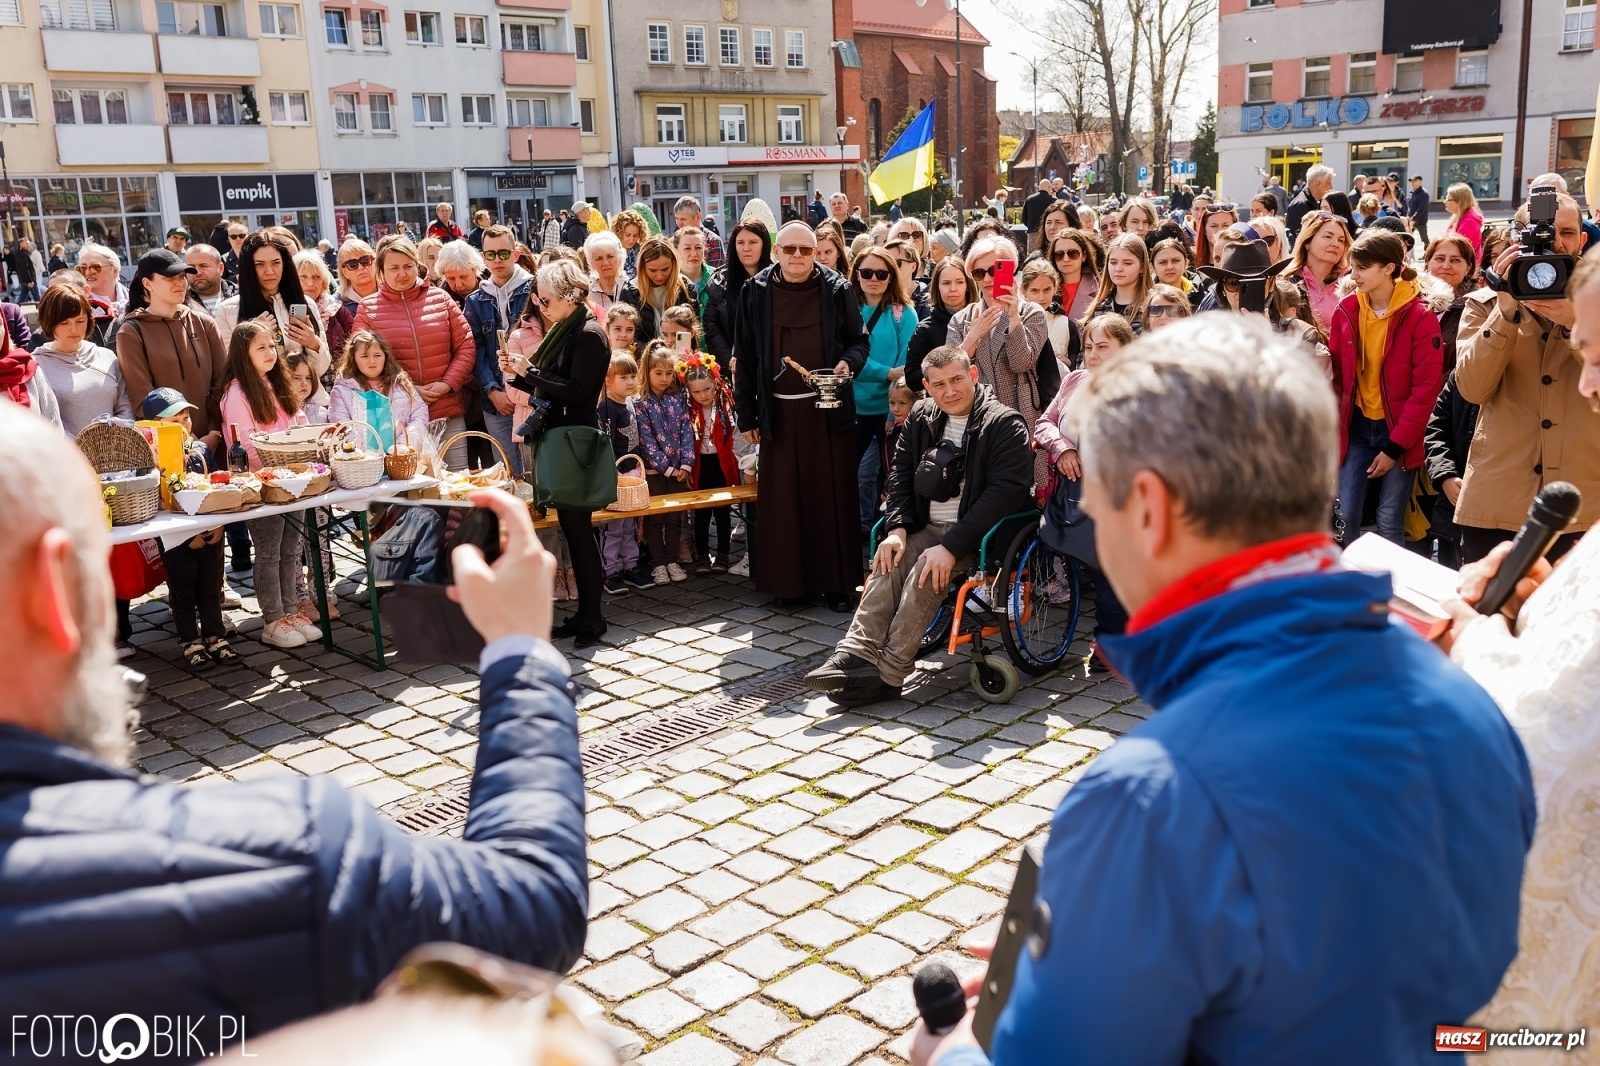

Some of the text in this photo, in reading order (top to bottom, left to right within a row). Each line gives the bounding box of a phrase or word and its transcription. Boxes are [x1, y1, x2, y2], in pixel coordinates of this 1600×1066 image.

[1240, 95, 1486, 132] BOLKO zaprasza
[680, 149, 695, 157] TEB
[765, 147, 827, 159] ROSSMANN
[1140, 167, 1147, 177] P
[226, 182, 272, 201] empik
